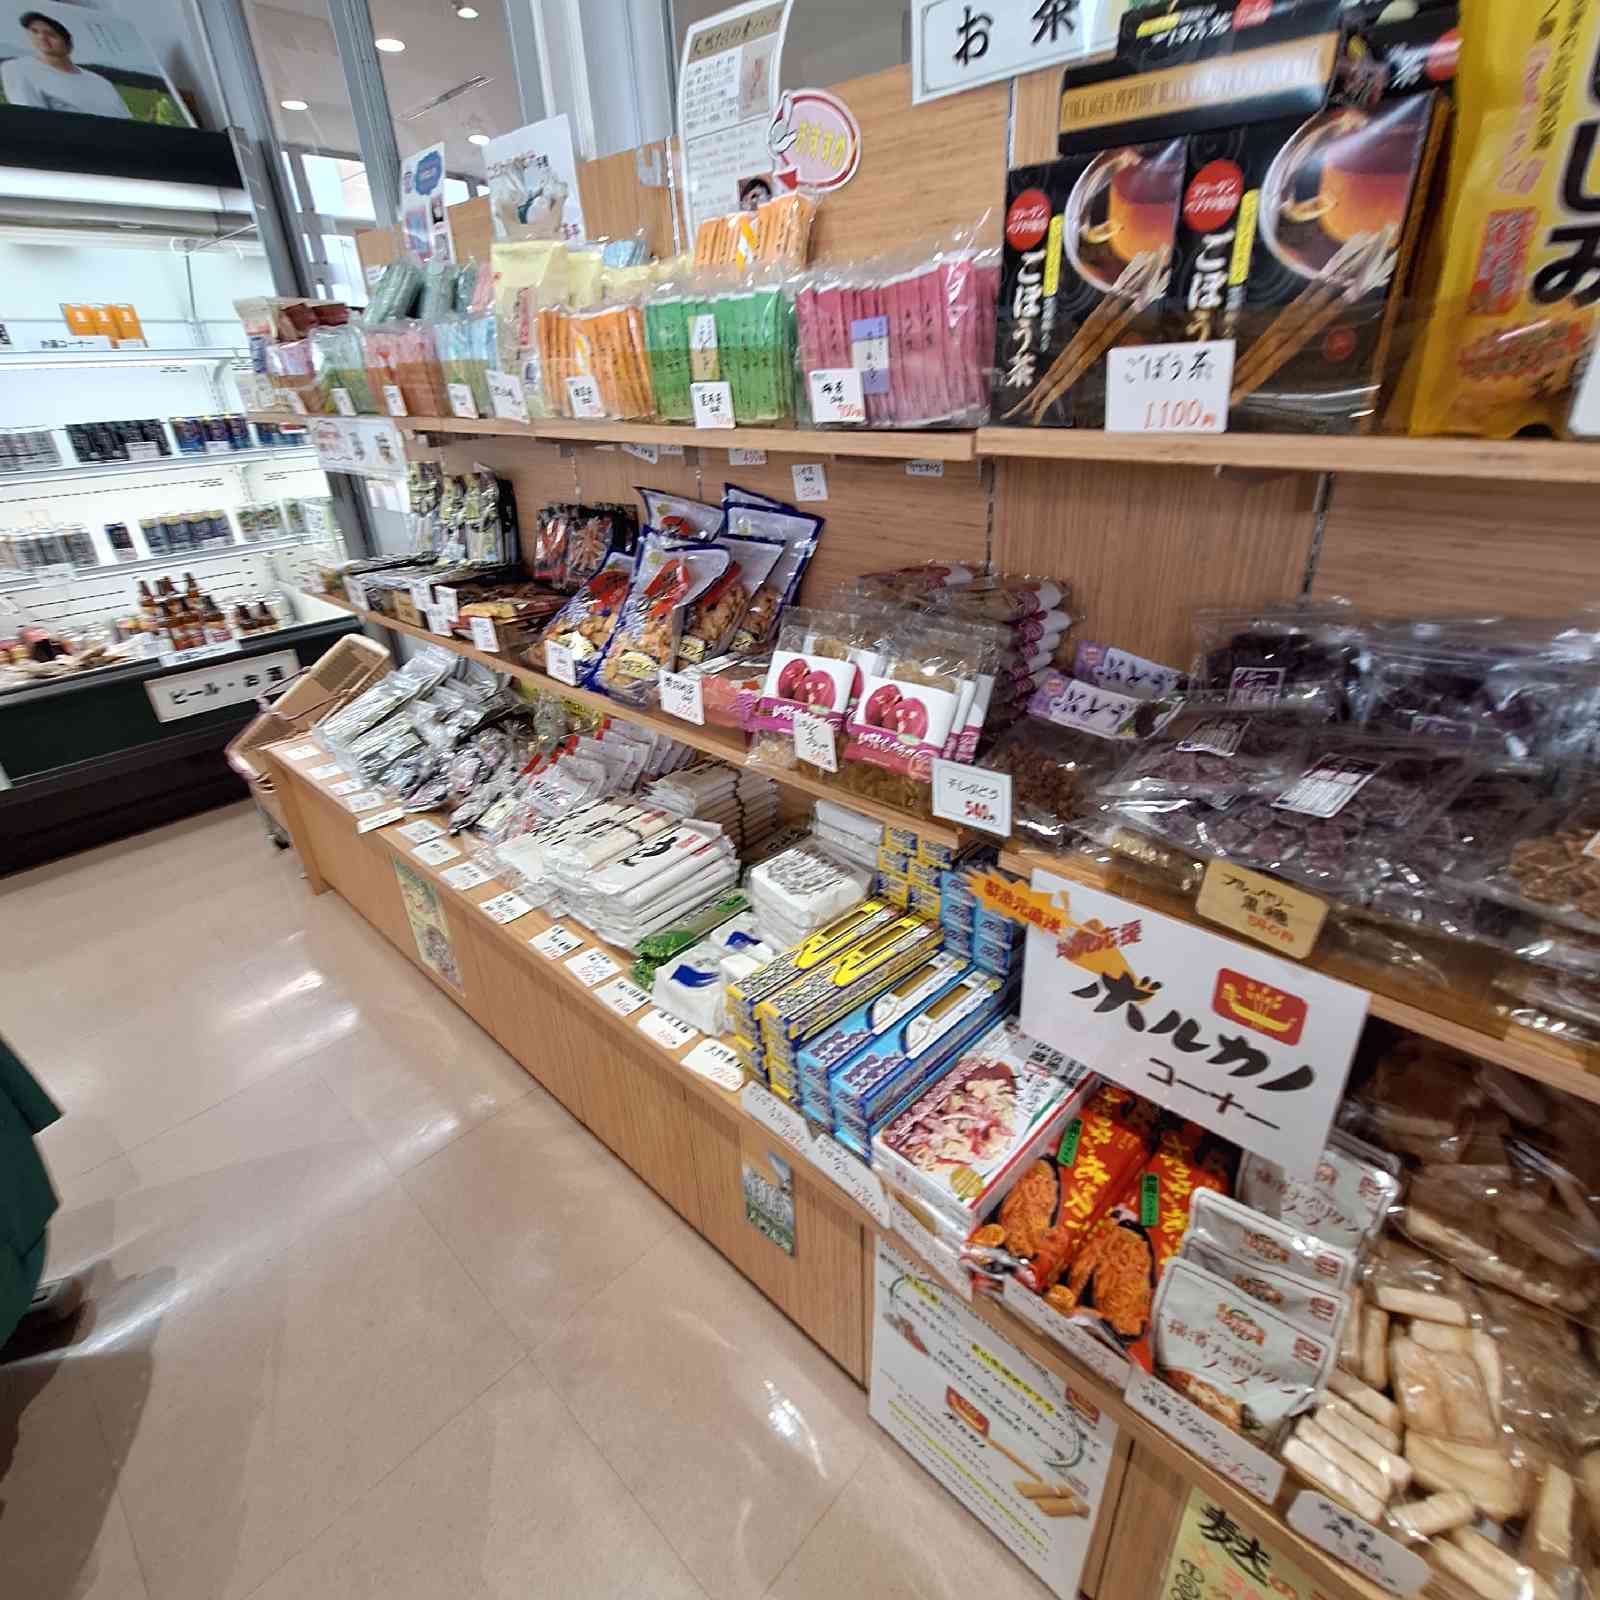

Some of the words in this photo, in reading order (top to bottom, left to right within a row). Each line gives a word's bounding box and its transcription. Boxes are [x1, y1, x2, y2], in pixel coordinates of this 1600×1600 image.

[1125, 349, 1214, 384] ごぼう茶
[1070, 972, 1315, 1092] ボルカノ
[1147, 1057, 1280, 1130] コーナー
